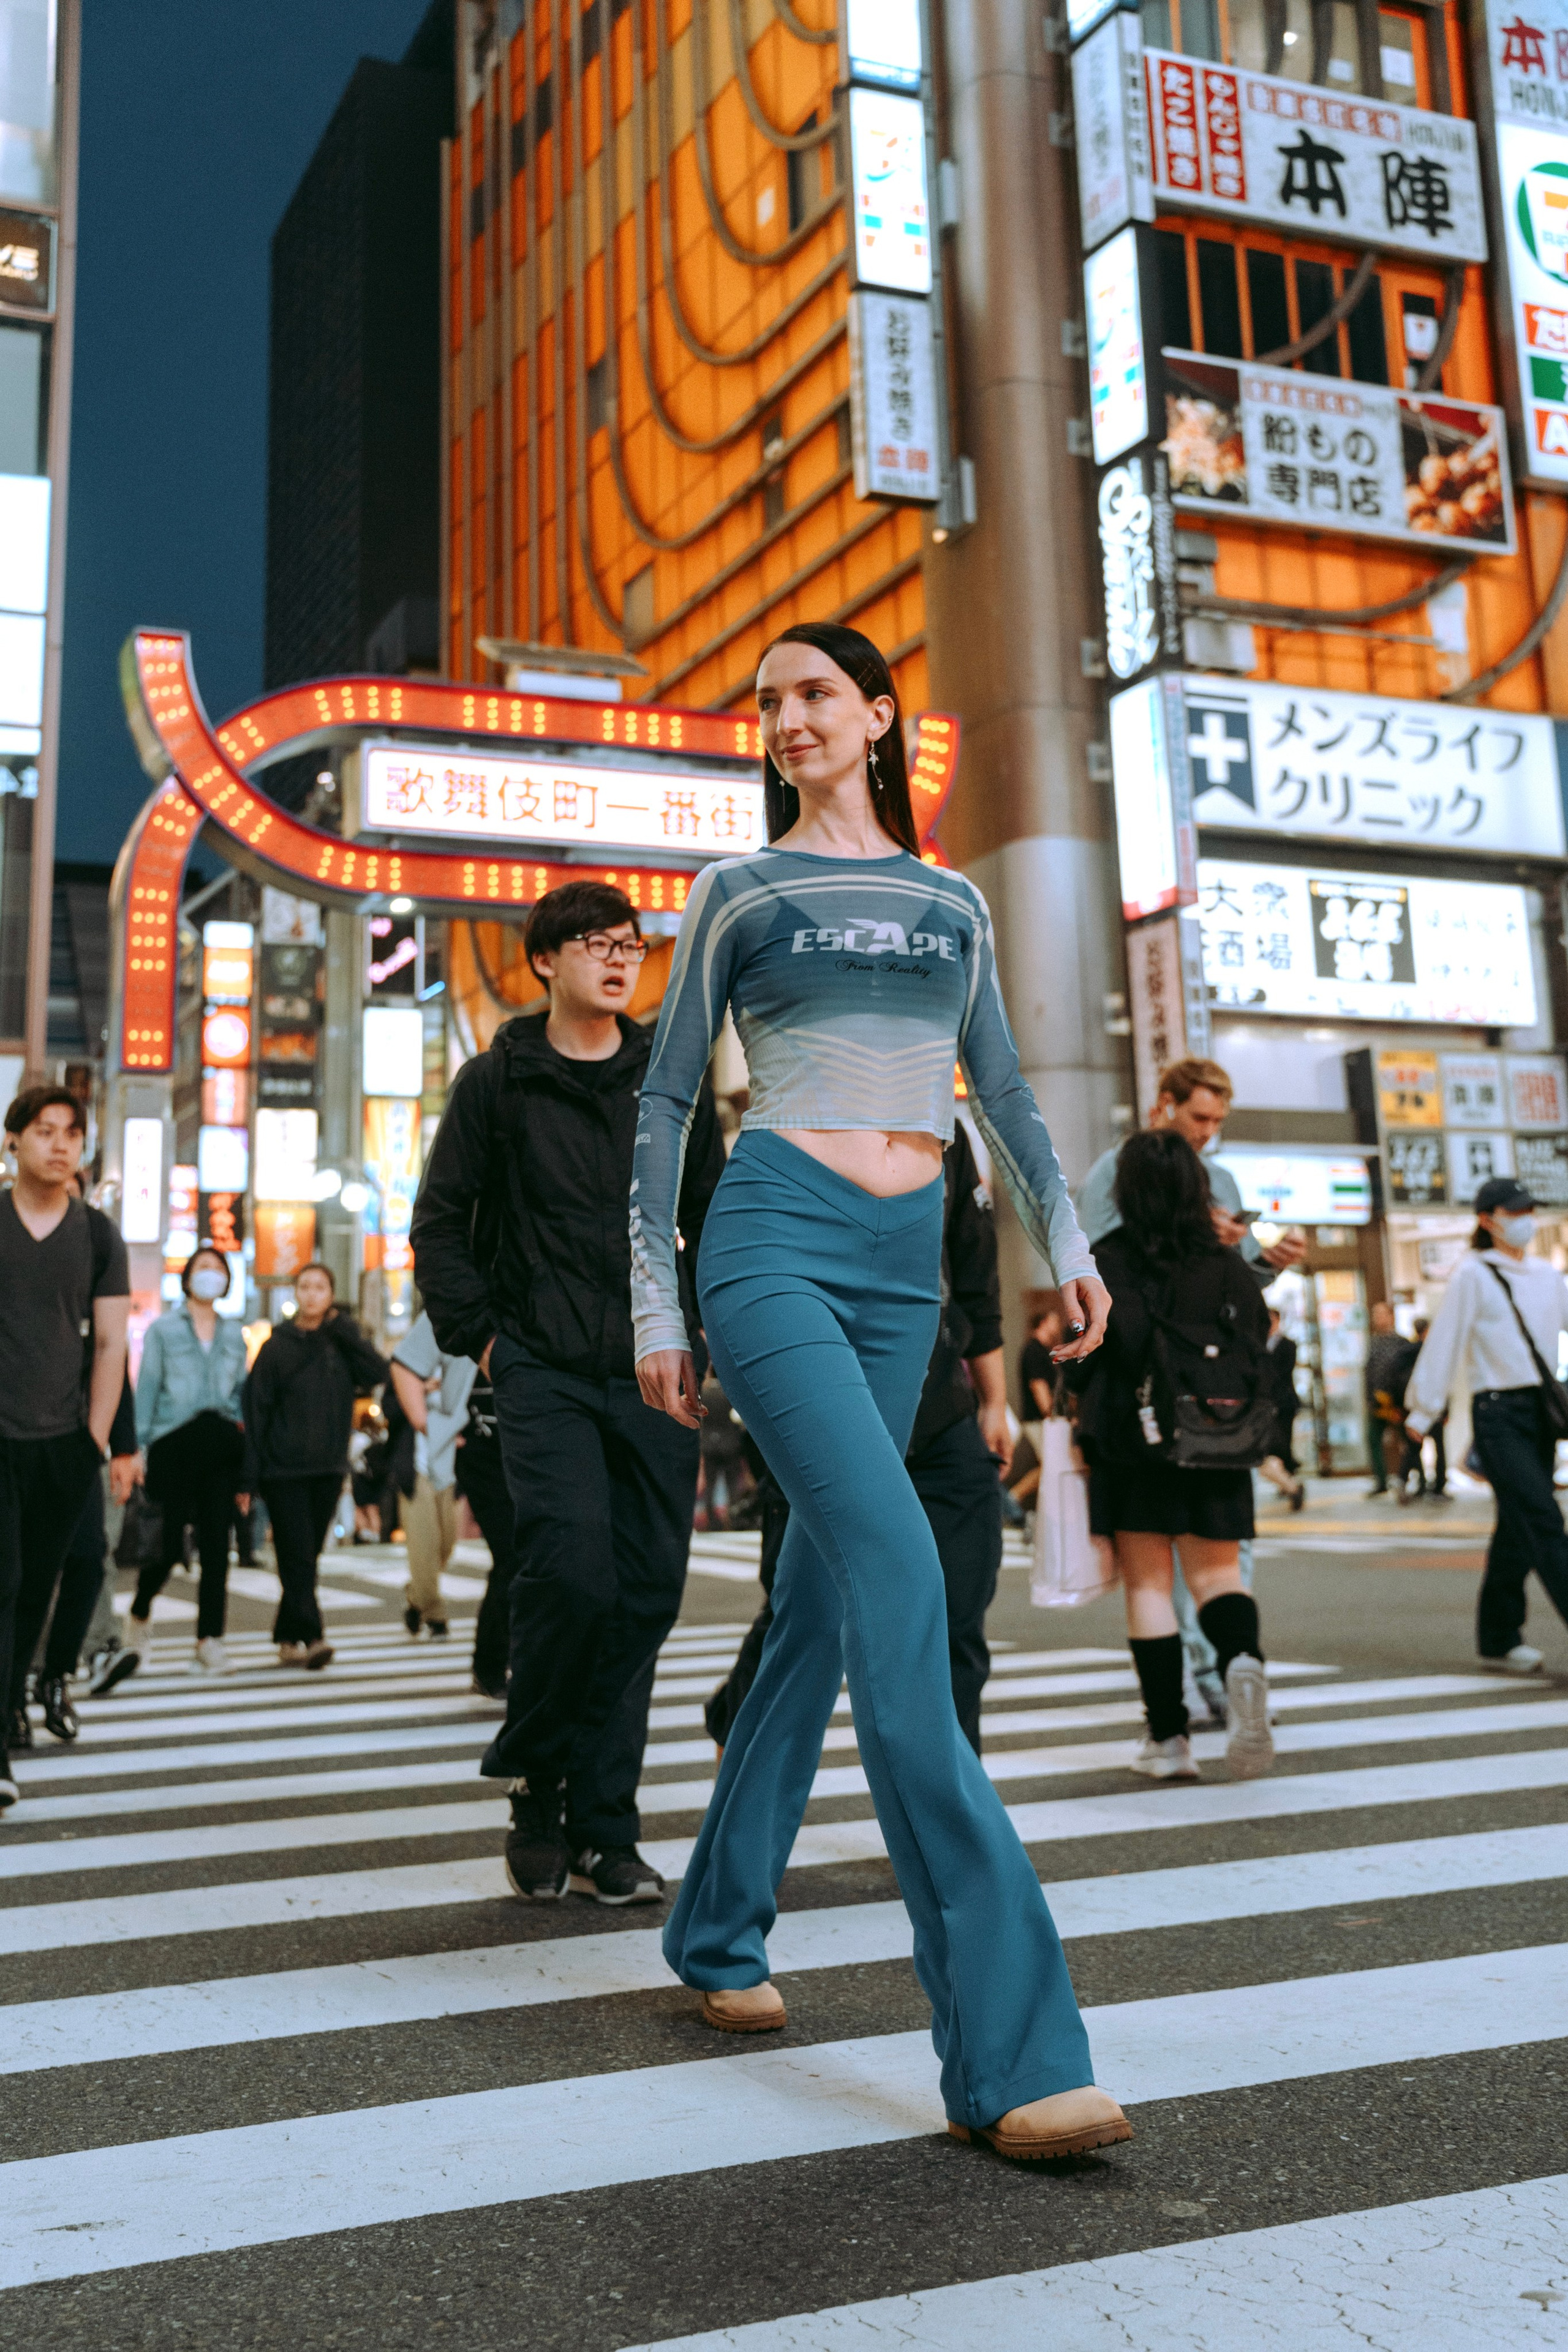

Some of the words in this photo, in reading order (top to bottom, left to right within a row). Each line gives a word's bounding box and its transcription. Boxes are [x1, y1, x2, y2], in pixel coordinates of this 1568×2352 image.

[1164, 64, 1197, 187] たこ焼き
[1206, 72, 1242, 197] もんじゃ焼き
[1276, 127, 1456, 238] 本陣
[1263, 412, 1378, 467] 粉もの
[1267, 463, 1382, 516] 専門店
[1267, 703, 1524, 772] メンズライフ
[386, 766, 753, 840] 歌舞伎町一番街
[1272, 769, 1483, 836] クリニック
[791, 919, 957, 962] ESCAPE
[835, 959, 875, 972] From
[879, 961, 932, 979] Reality
